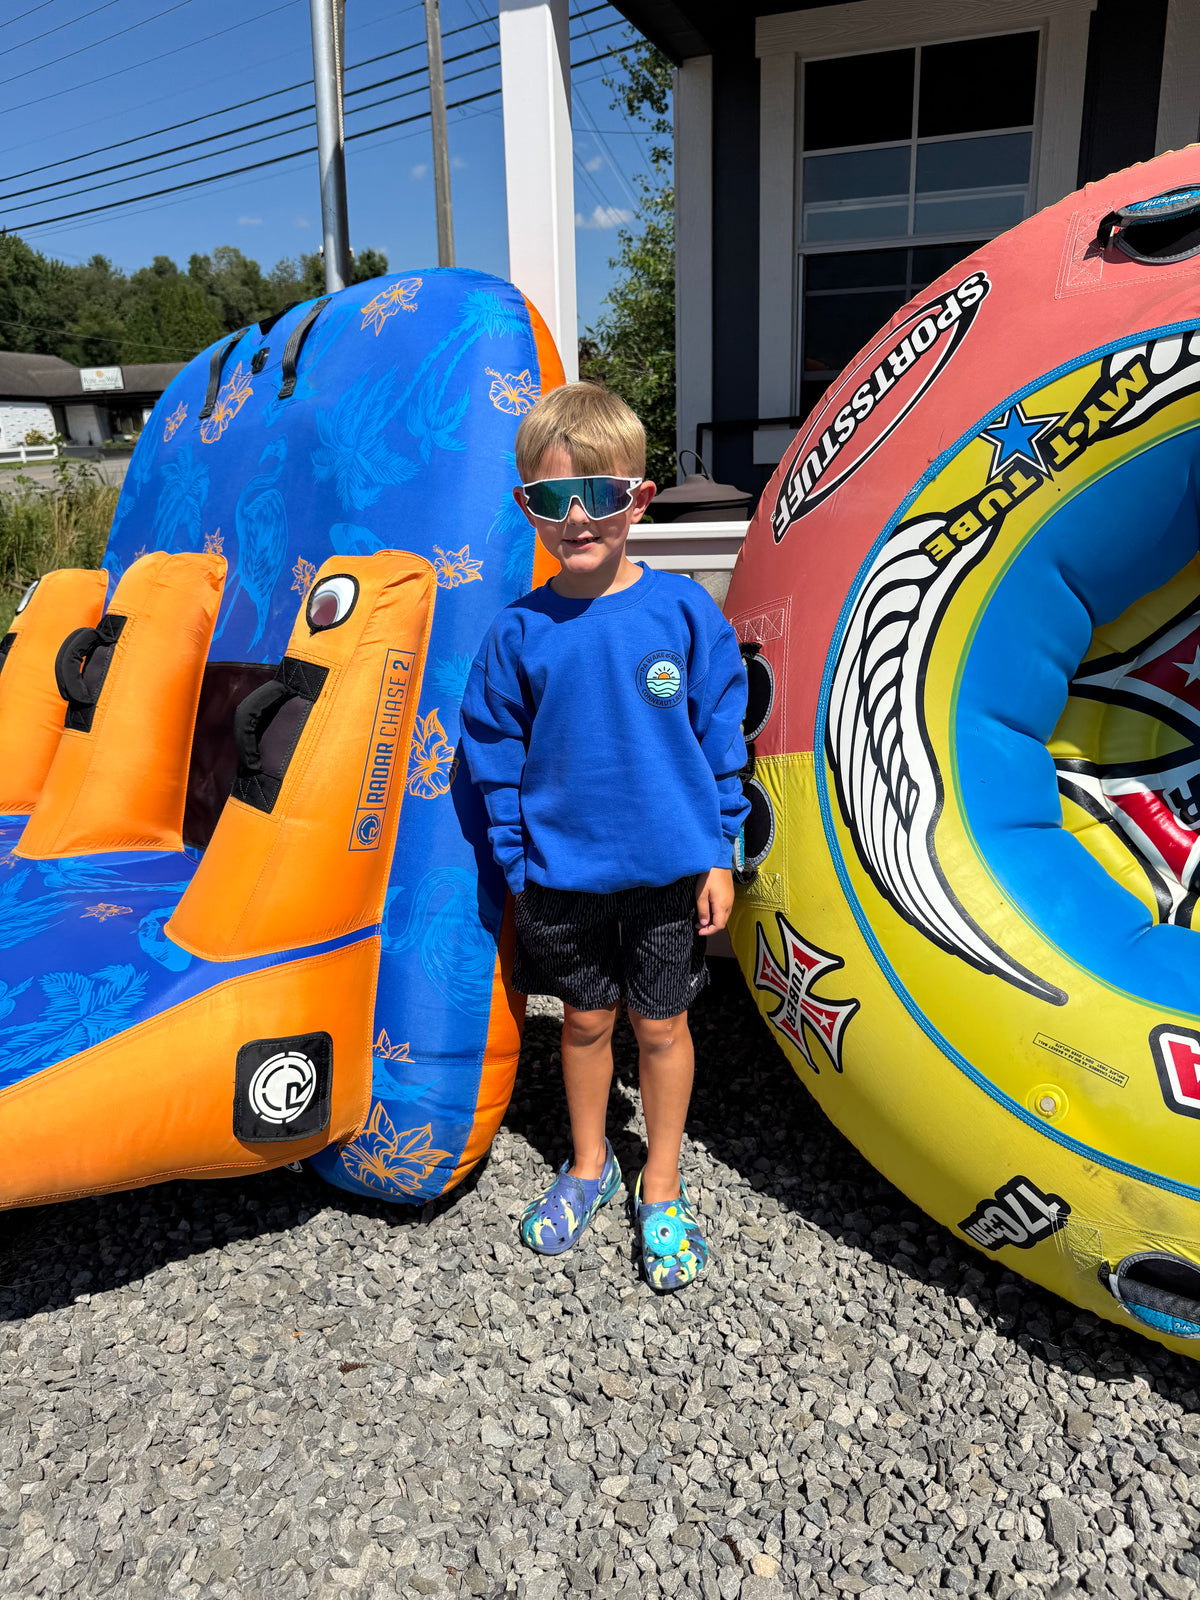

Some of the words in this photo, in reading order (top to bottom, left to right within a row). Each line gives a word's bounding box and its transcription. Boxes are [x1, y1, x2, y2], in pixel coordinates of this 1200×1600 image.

[775, 274, 985, 536] SPORTSSTUFF
[925, 470, 1037, 561] TUBE
[392, 659, 410, 672] 2
[647, 652, 665, 664] WAKE
[671, 654, 684, 672] SKATE
[379, 676, 407, 737] CHASE
[642, 689, 672, 706] CONNEAUT
[672, 690, 683, 703] LAKE
[366, 742, 394, 803] RADAR
[785, 961, 806, 1031] TUBER
[1108, 1075, 1123, 1084] SAFETY
